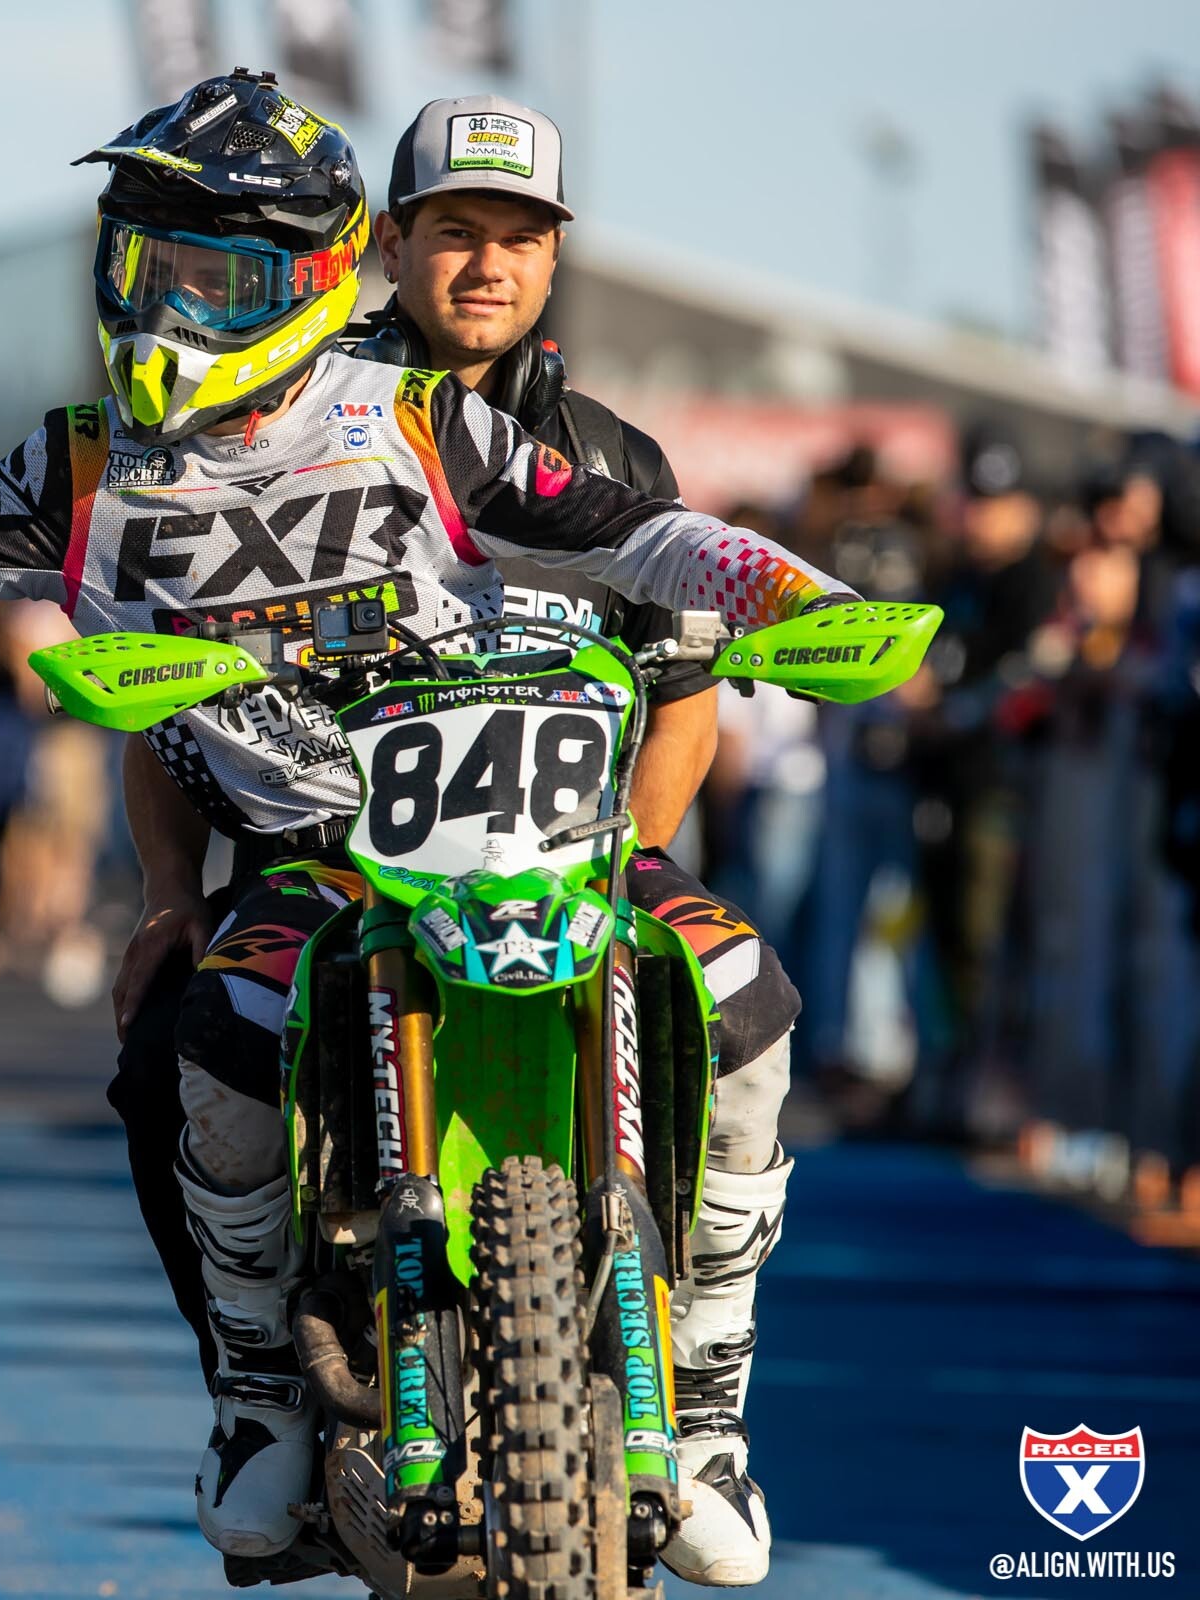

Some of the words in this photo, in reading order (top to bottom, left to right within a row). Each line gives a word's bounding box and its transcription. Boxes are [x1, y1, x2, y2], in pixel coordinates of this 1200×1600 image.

[467, 132, 519, 147] CIRCUIT
[453, 158, 493, 167] Kawasaki
[465, 147, 519, 159] NAMURA
[228, 172, 282, 188] LS2
[235, 306, 328, 386] LS2
[325, 403, 383, 421] AMA
[348, 431, 366, 443] FIM
[227, 439, 270, 458] REVO
[110, 452, 148, 468] TOP
[109, 465, 175, 482] SECRET
[108, 479, 173, 488] DESIGNS
[114, 485, 428, 601] FXR
[774, 644, 866, 665] CIRCUIT
[118, 659, 208, 687] CIRCUIT
[438, 684, 543, 703] MONSTER
[454, 697, 530, 708] ENERGY
[546, 690, 591, 704] AMA
[371, 701, 414, 721] AMA
[369, 708, 608, 858] 848
[496, 941, 535, 955] T3
[367, 990, 404, 1170] MX-TECH
[612, 973, 646, 1176] MX-TECH
[612, 1231, 652, 1349] SECRE
[625, 1349, 659, 1419] TOP
[383, 1439, 443, 1471] EVOL
